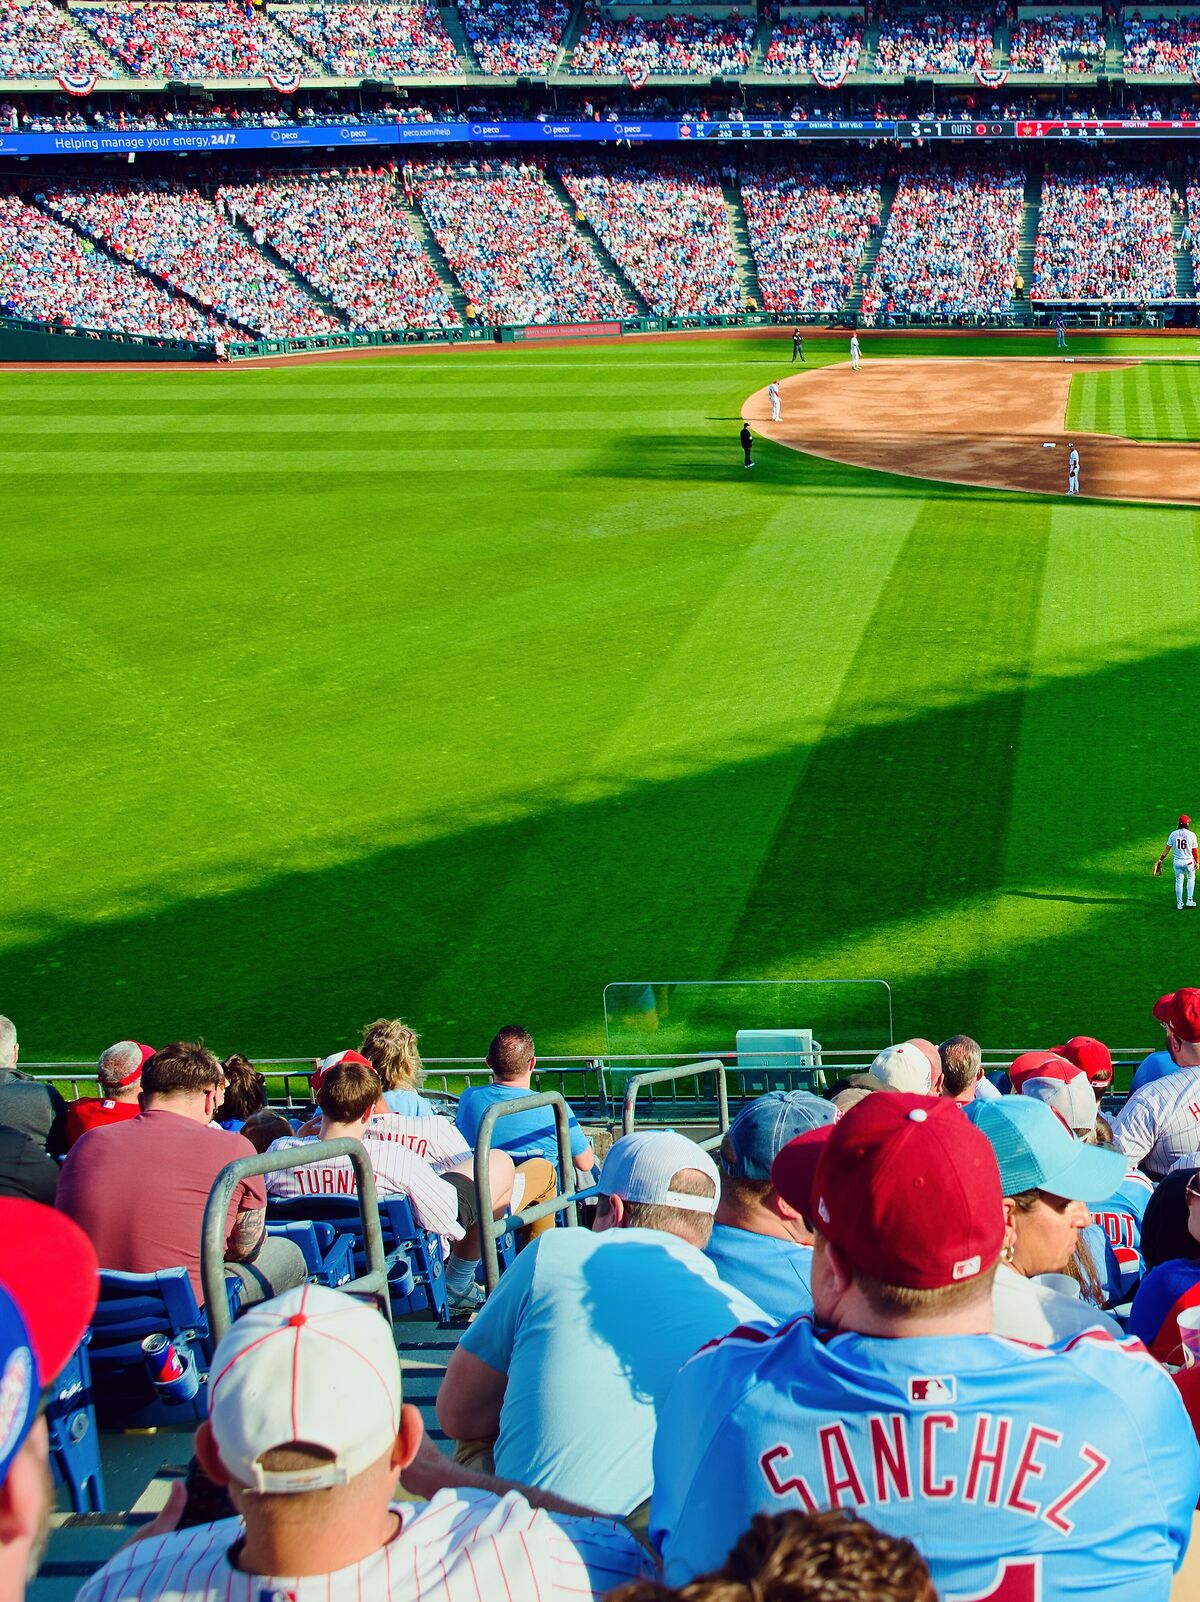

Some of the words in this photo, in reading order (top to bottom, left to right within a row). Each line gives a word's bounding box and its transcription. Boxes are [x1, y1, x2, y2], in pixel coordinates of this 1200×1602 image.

[403, 129, 451, 137] peco.com/help
[482, 126, 500, 134] peco
[553, 126, 570, 134] peco
[624, 126, 641, 134] peco
[952, 124, 972, 134] OUTS
[281, 132, 298, 140] peco
[350, 130, 367, 138] peco
[55, 137, 98, 150] Helping
[101, 138, 145, 149] manage
[147, 136, 170, 149] your
[759, 1411, 1112, 1537] SANCHEZ
